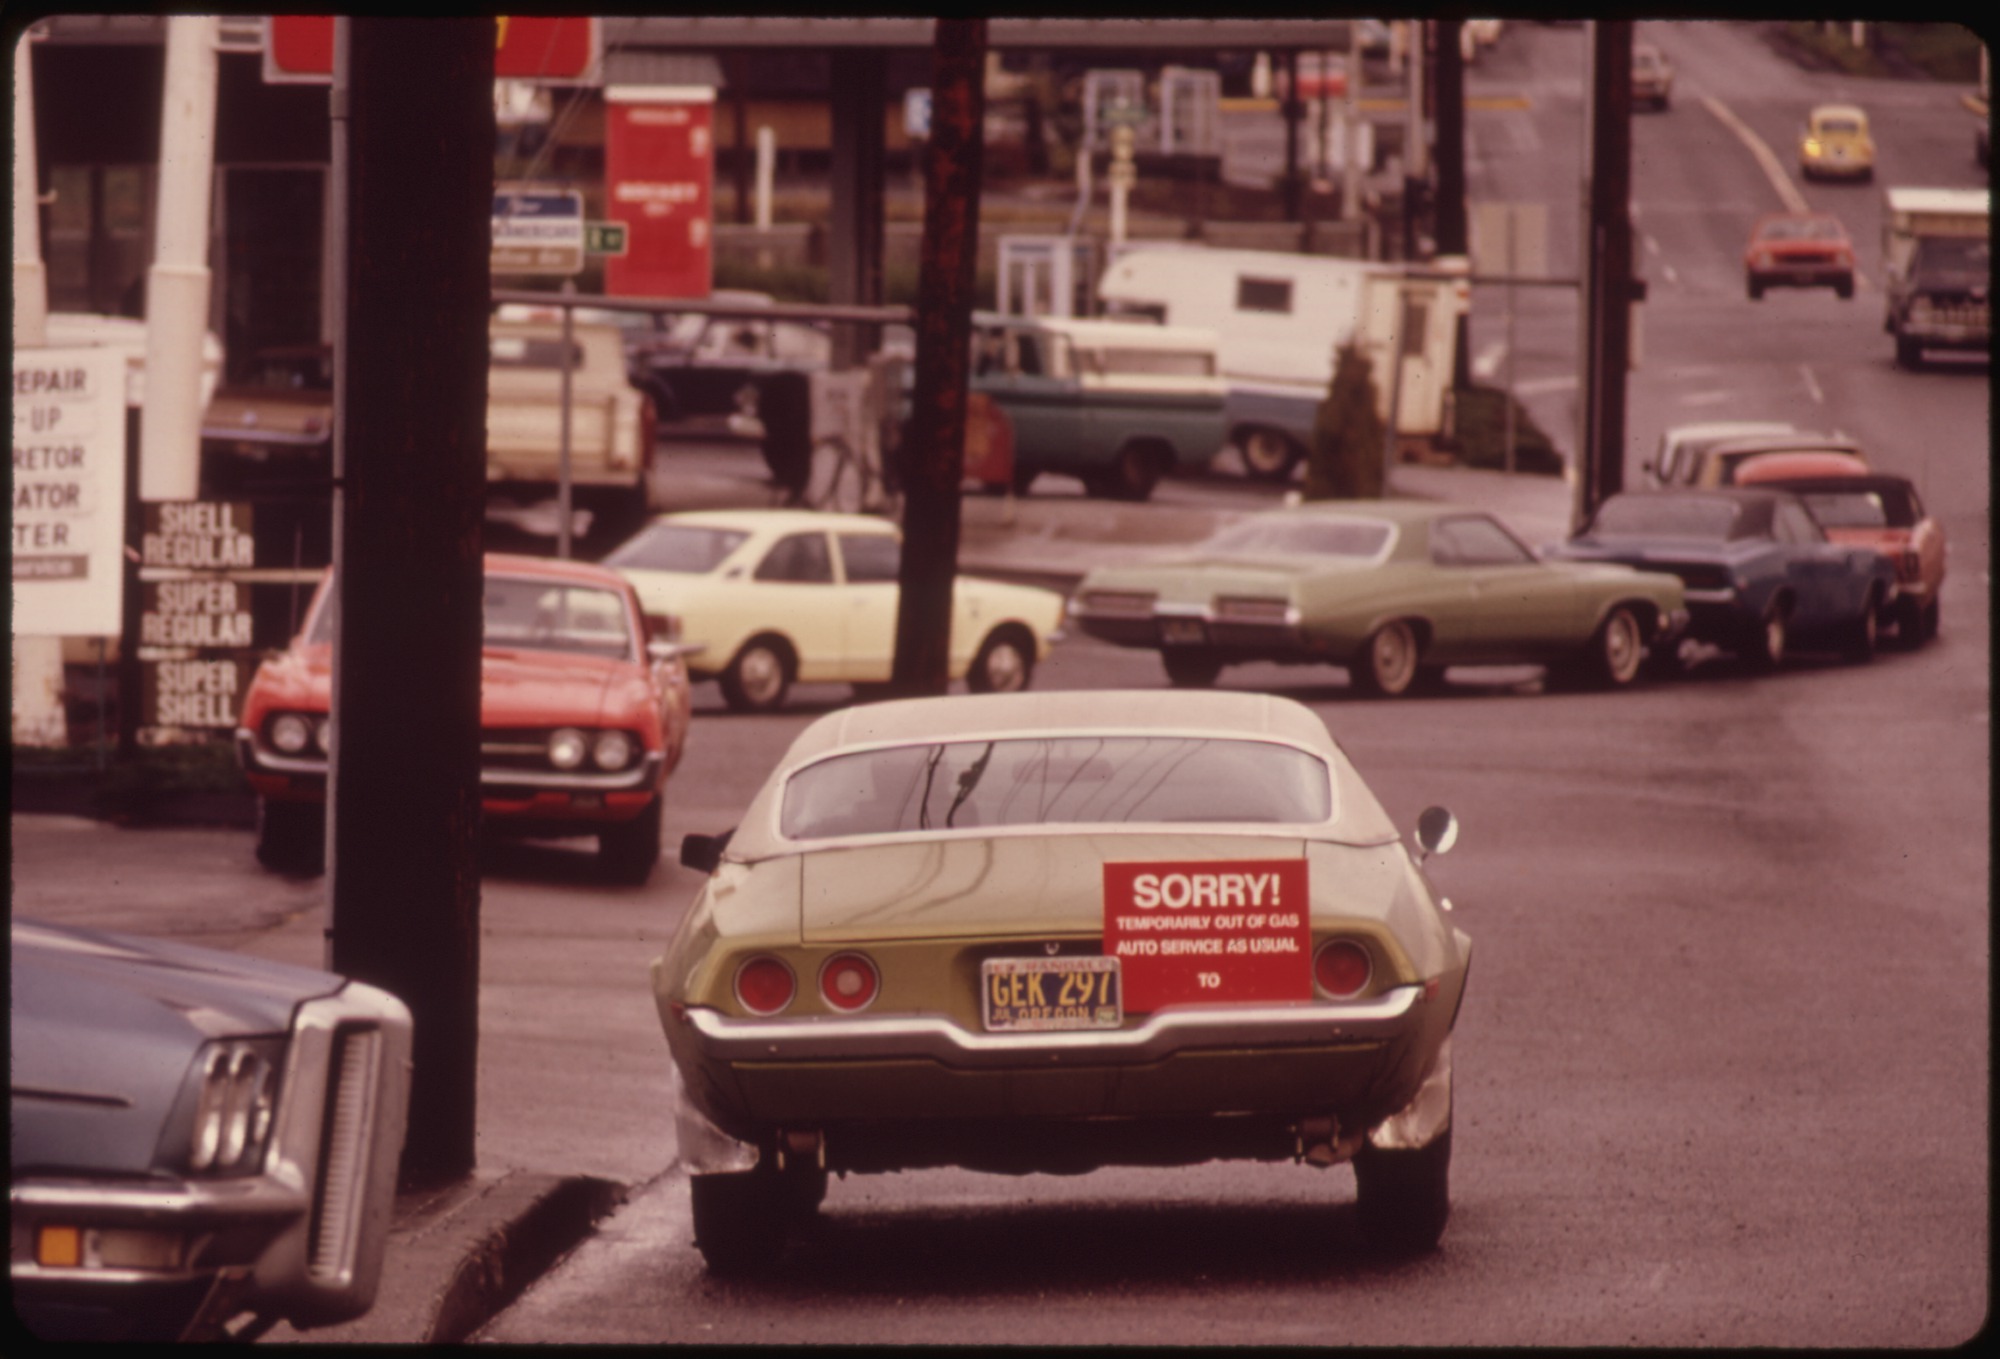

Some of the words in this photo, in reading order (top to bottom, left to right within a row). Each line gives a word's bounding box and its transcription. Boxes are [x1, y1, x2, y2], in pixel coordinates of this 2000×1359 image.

[15, 523, 69, 547] TER
[160, 502, 238, 535] SHELL
[143, 534, 254, 568] REGULAR
[158, 581, 237, 612] SUPER
[143, 612, 252, 646] REGULAR
[158, 661, 237, 694] SUPER
[158, 693, 237, 727] SHELL
[1133, 873, 1281, 909] SORRY!
[1117, 915, 1211, 930] TEMPORARILY
[1214, 914, 1244, 929] OUT
[1247, 913, 1267, 928] OF
[1269, 912, 1299, 928] GAS
[1116, 939, 1158, 955] AUTO
[1160, 938, 1223, 955] SERVICE
[1227, 938, 1248, 954] AS
[1250, 937, 1299, 953] USUAL
[992, 972, 1047, 1007] GEK
[1059, 972, 1110, 1006] 297
[1197, 972, 1220, 988] TO
